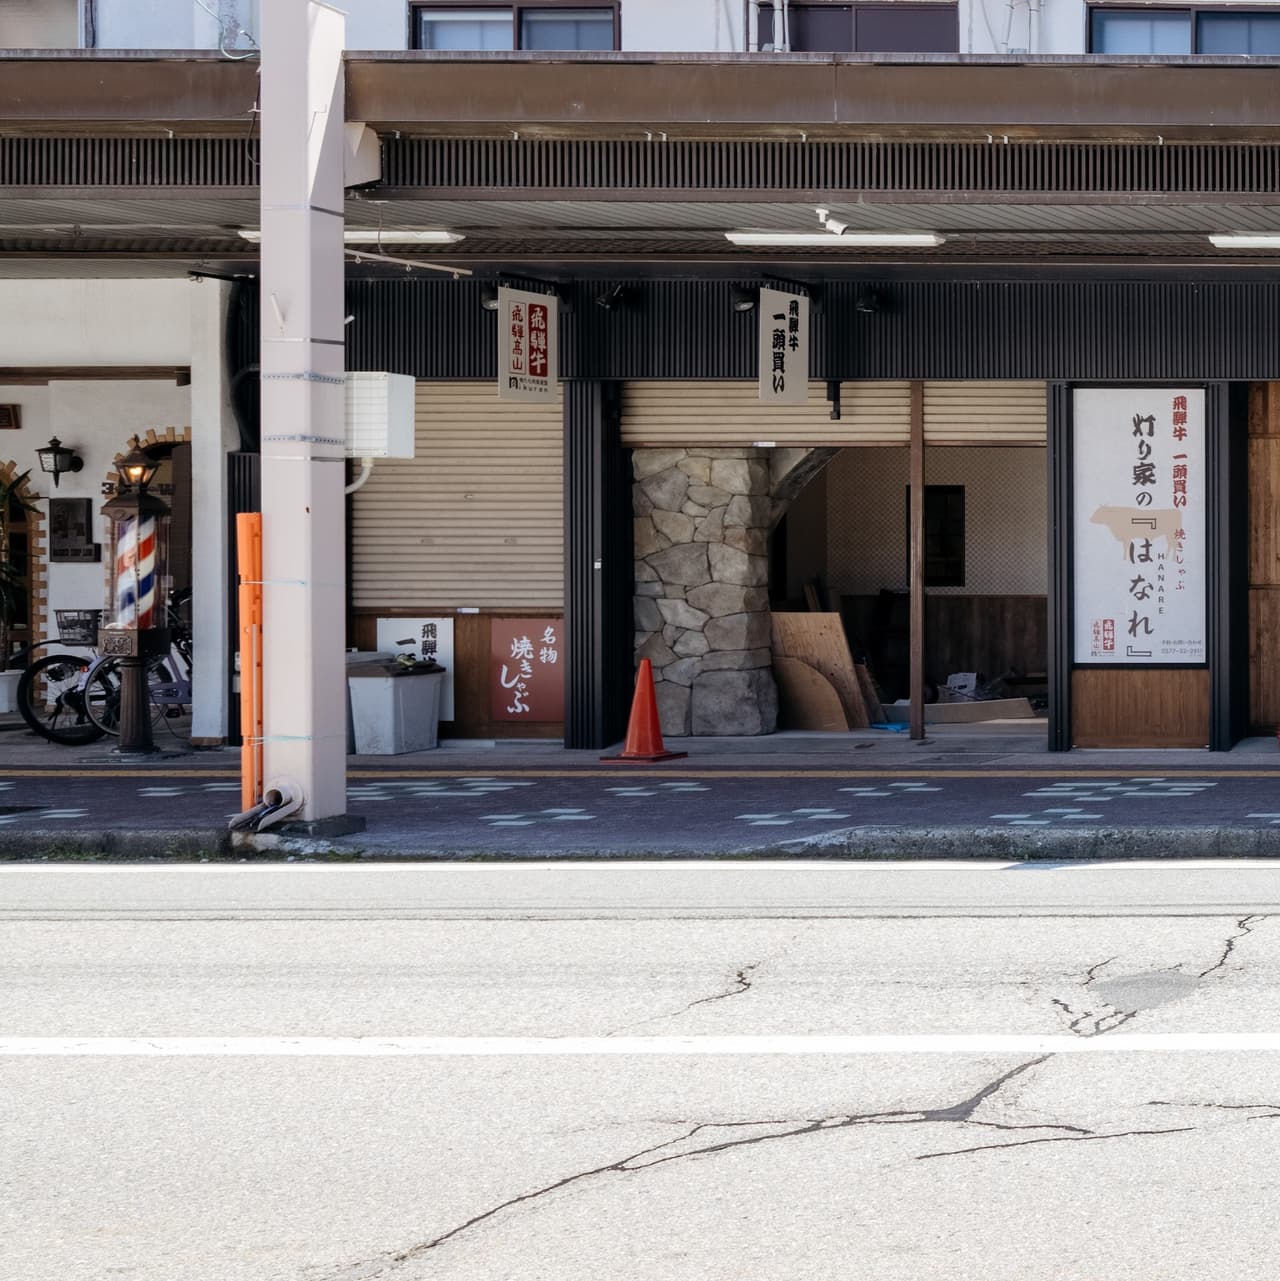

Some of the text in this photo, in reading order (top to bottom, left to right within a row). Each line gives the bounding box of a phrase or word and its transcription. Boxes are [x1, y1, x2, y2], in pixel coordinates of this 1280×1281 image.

[511, 304, 524, 370] 飛騨高山
[530, 307, 546, 374] 飛騨牛
[772, 313, 786, 394] 一頭買い
[1172, 395, 1188, 442] 飛騨牛
[1172, 453, 1188, 508] 一頭買い
[1157, 552, 1165, 615] HANARE
[500, 635, 535, 714] 焼きしゃぶ
[539, 625, 558, 664] 名物
